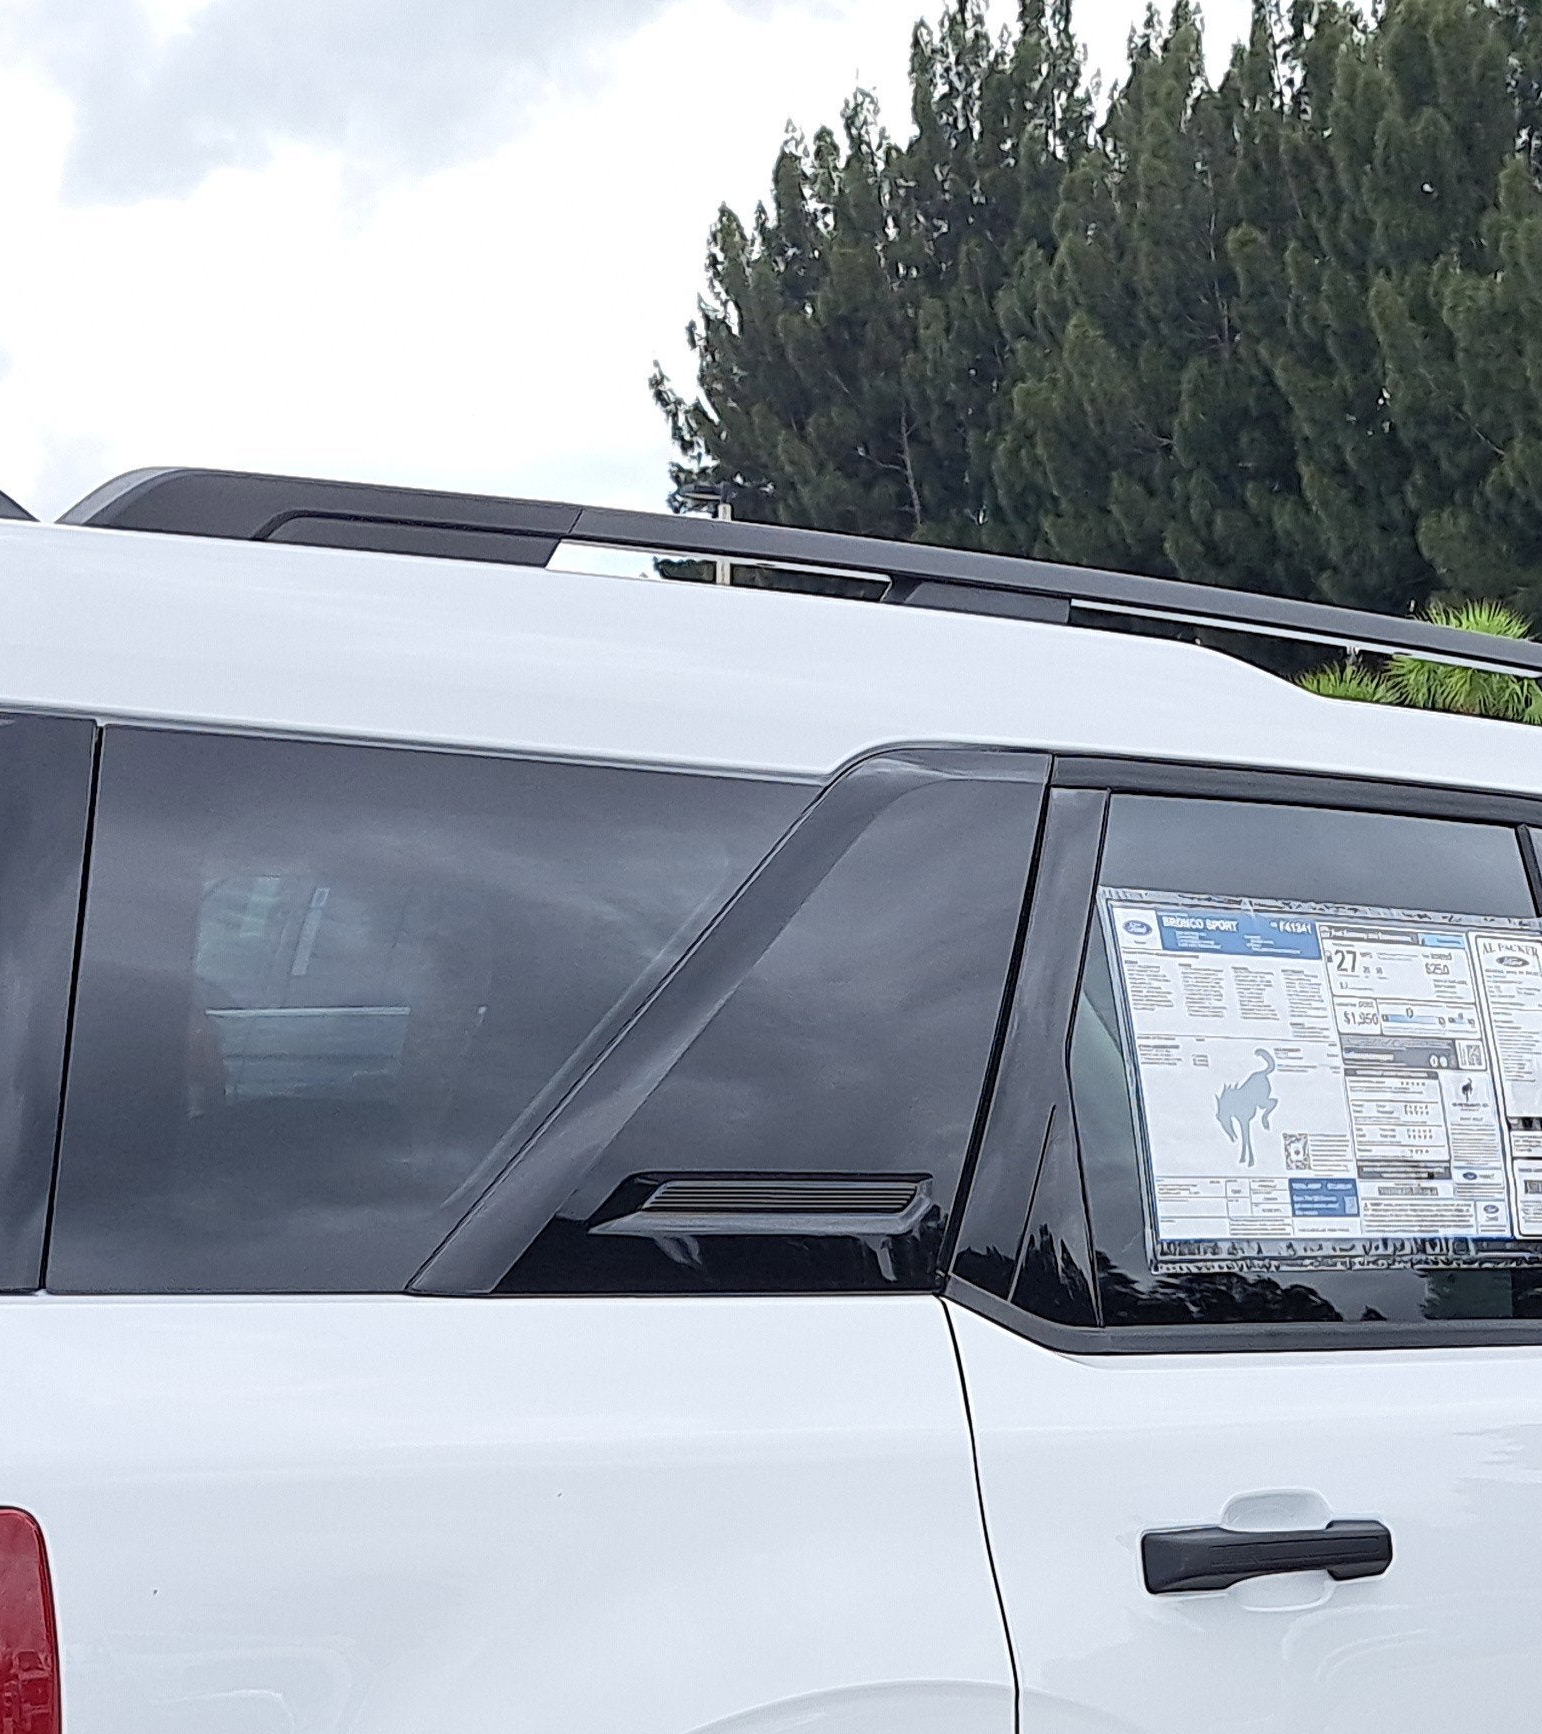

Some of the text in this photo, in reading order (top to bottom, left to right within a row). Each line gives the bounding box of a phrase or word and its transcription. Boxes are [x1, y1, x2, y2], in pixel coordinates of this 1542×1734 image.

[1162, 916, 1238, 932] BRONCO SPORT
[1335, 949, 1356, 972] 27
